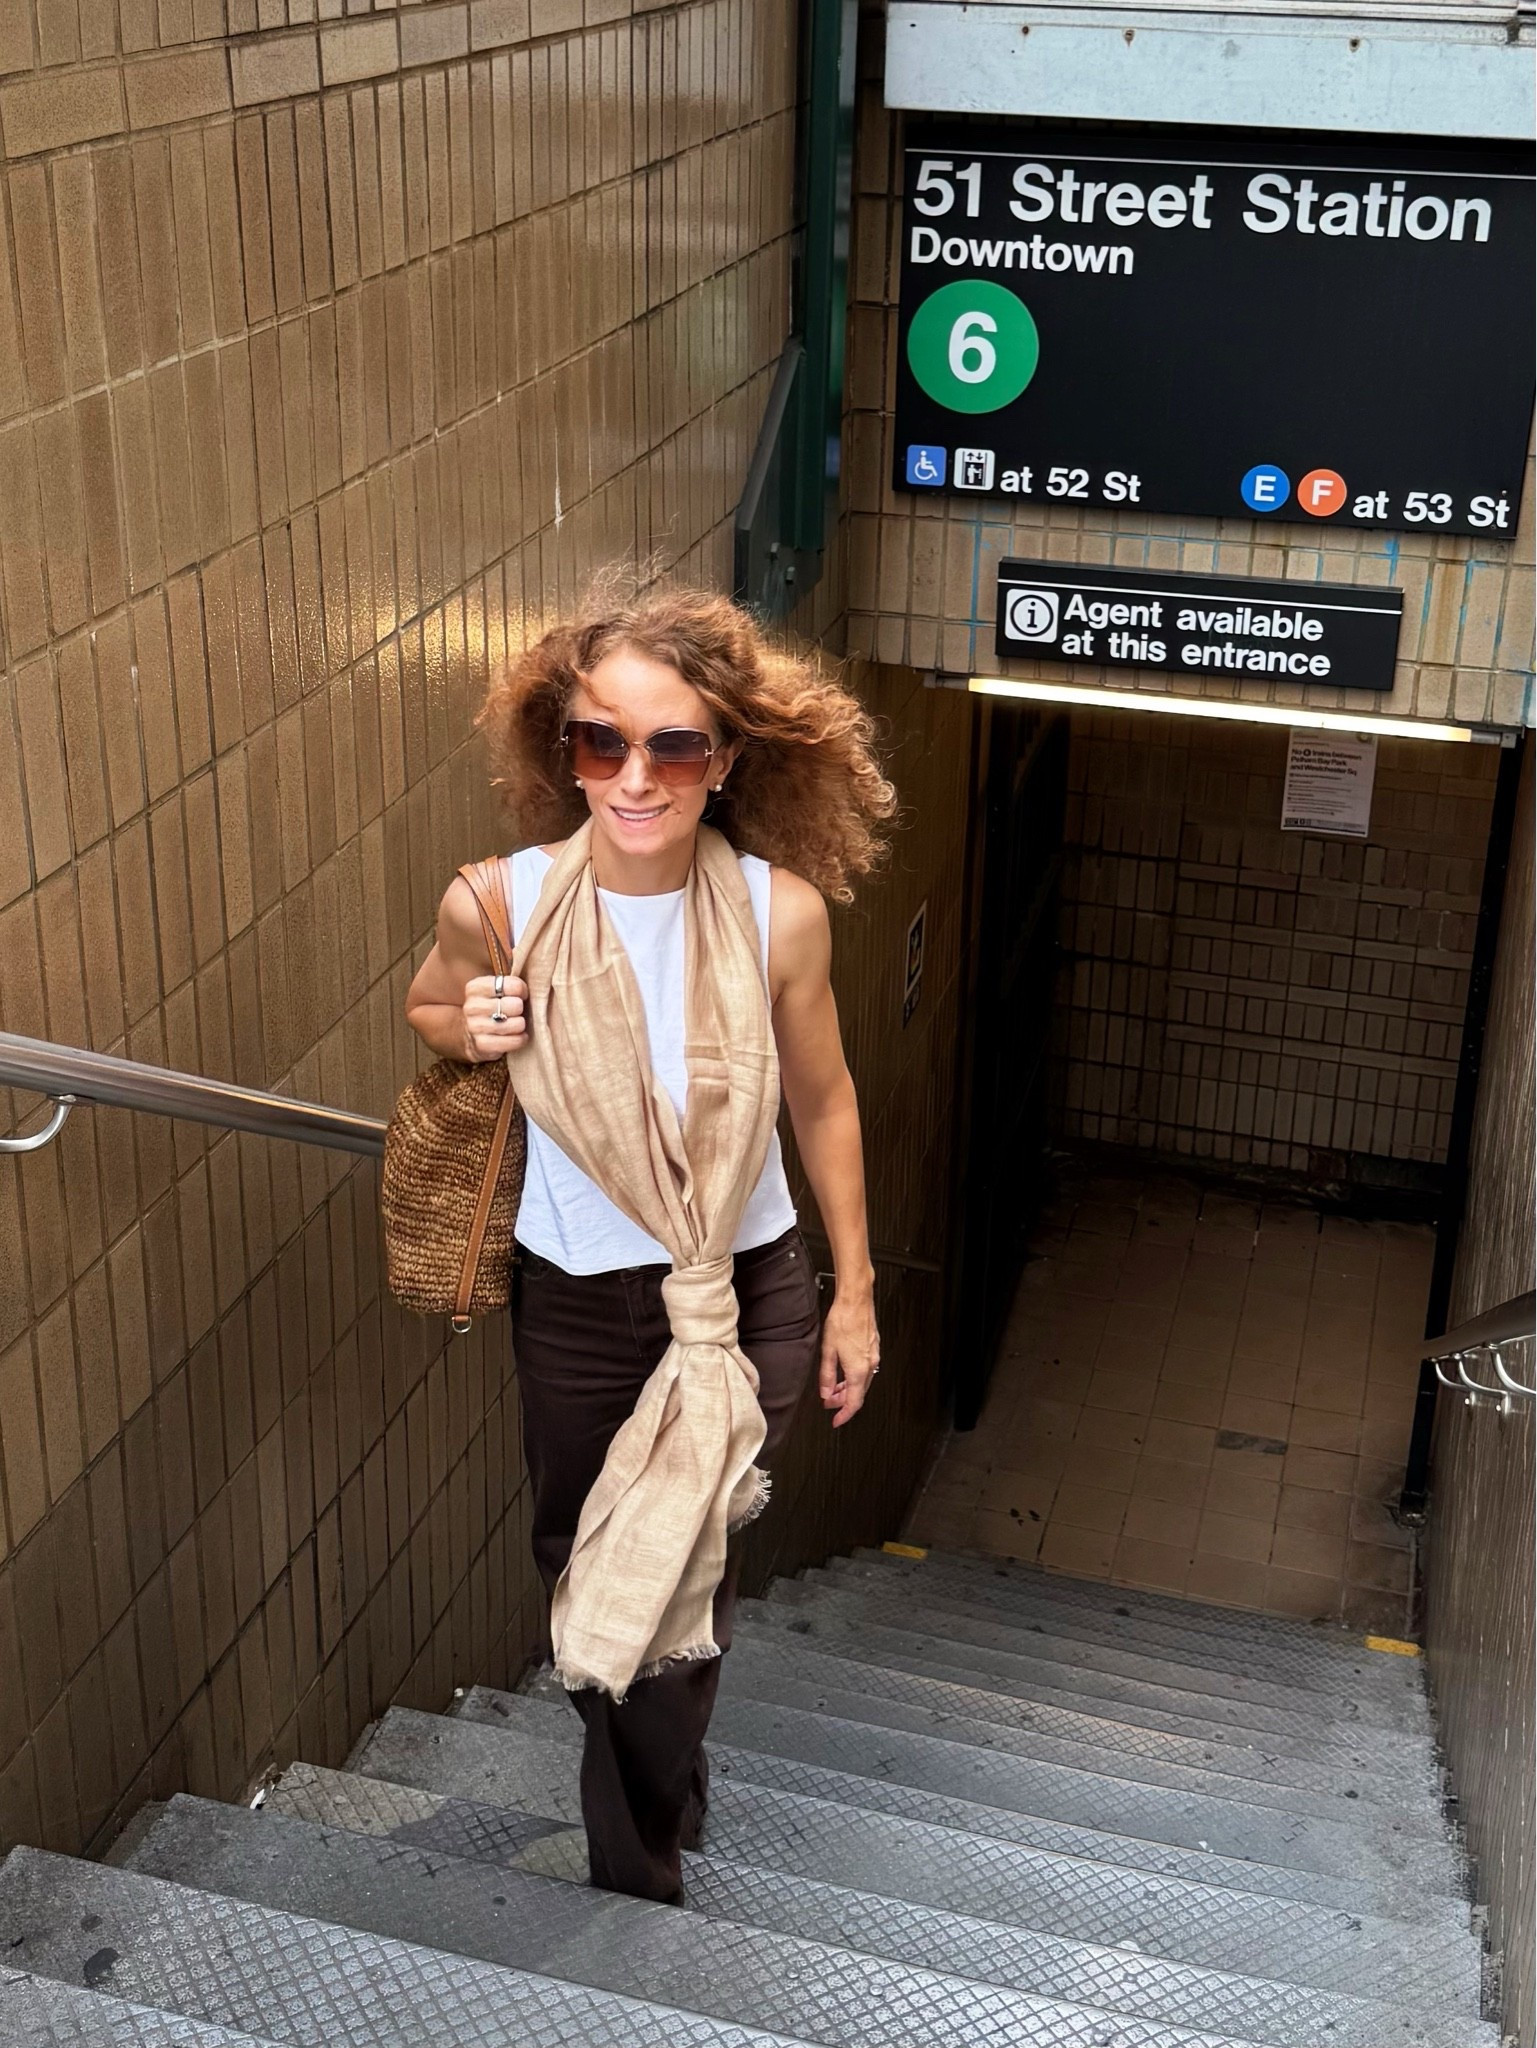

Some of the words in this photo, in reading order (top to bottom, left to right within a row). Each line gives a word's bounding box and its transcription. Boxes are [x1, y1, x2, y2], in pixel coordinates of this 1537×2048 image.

[913, 160, 982, 218] 51
[1009, 163, 1214, 230] Street
[1242, 173, 1492, 242] Station
[910, 226, 1134, 275] Downtown
[948, 311, 998, 384] 6
[999, 466, 1034, 494] at
[1045, 467, 1090, 499] 52
[1102, 471, 1142, 503] St
[1254, 474, 1277, 502] E
[1311, 478, 1335, 506] F
[1352, 490, 1390, 520] at
[1402, 491, 1453, 524] 53
[1467, 495, 1511, 528] St
[1063, 594, 1163, 630] Agent
[1176, 605, 1324, 642] available
[1061, 629, 1095, 656] at
[1107, 632, 1167, 663] this
[1180, 641, 1332, 677] entrance
